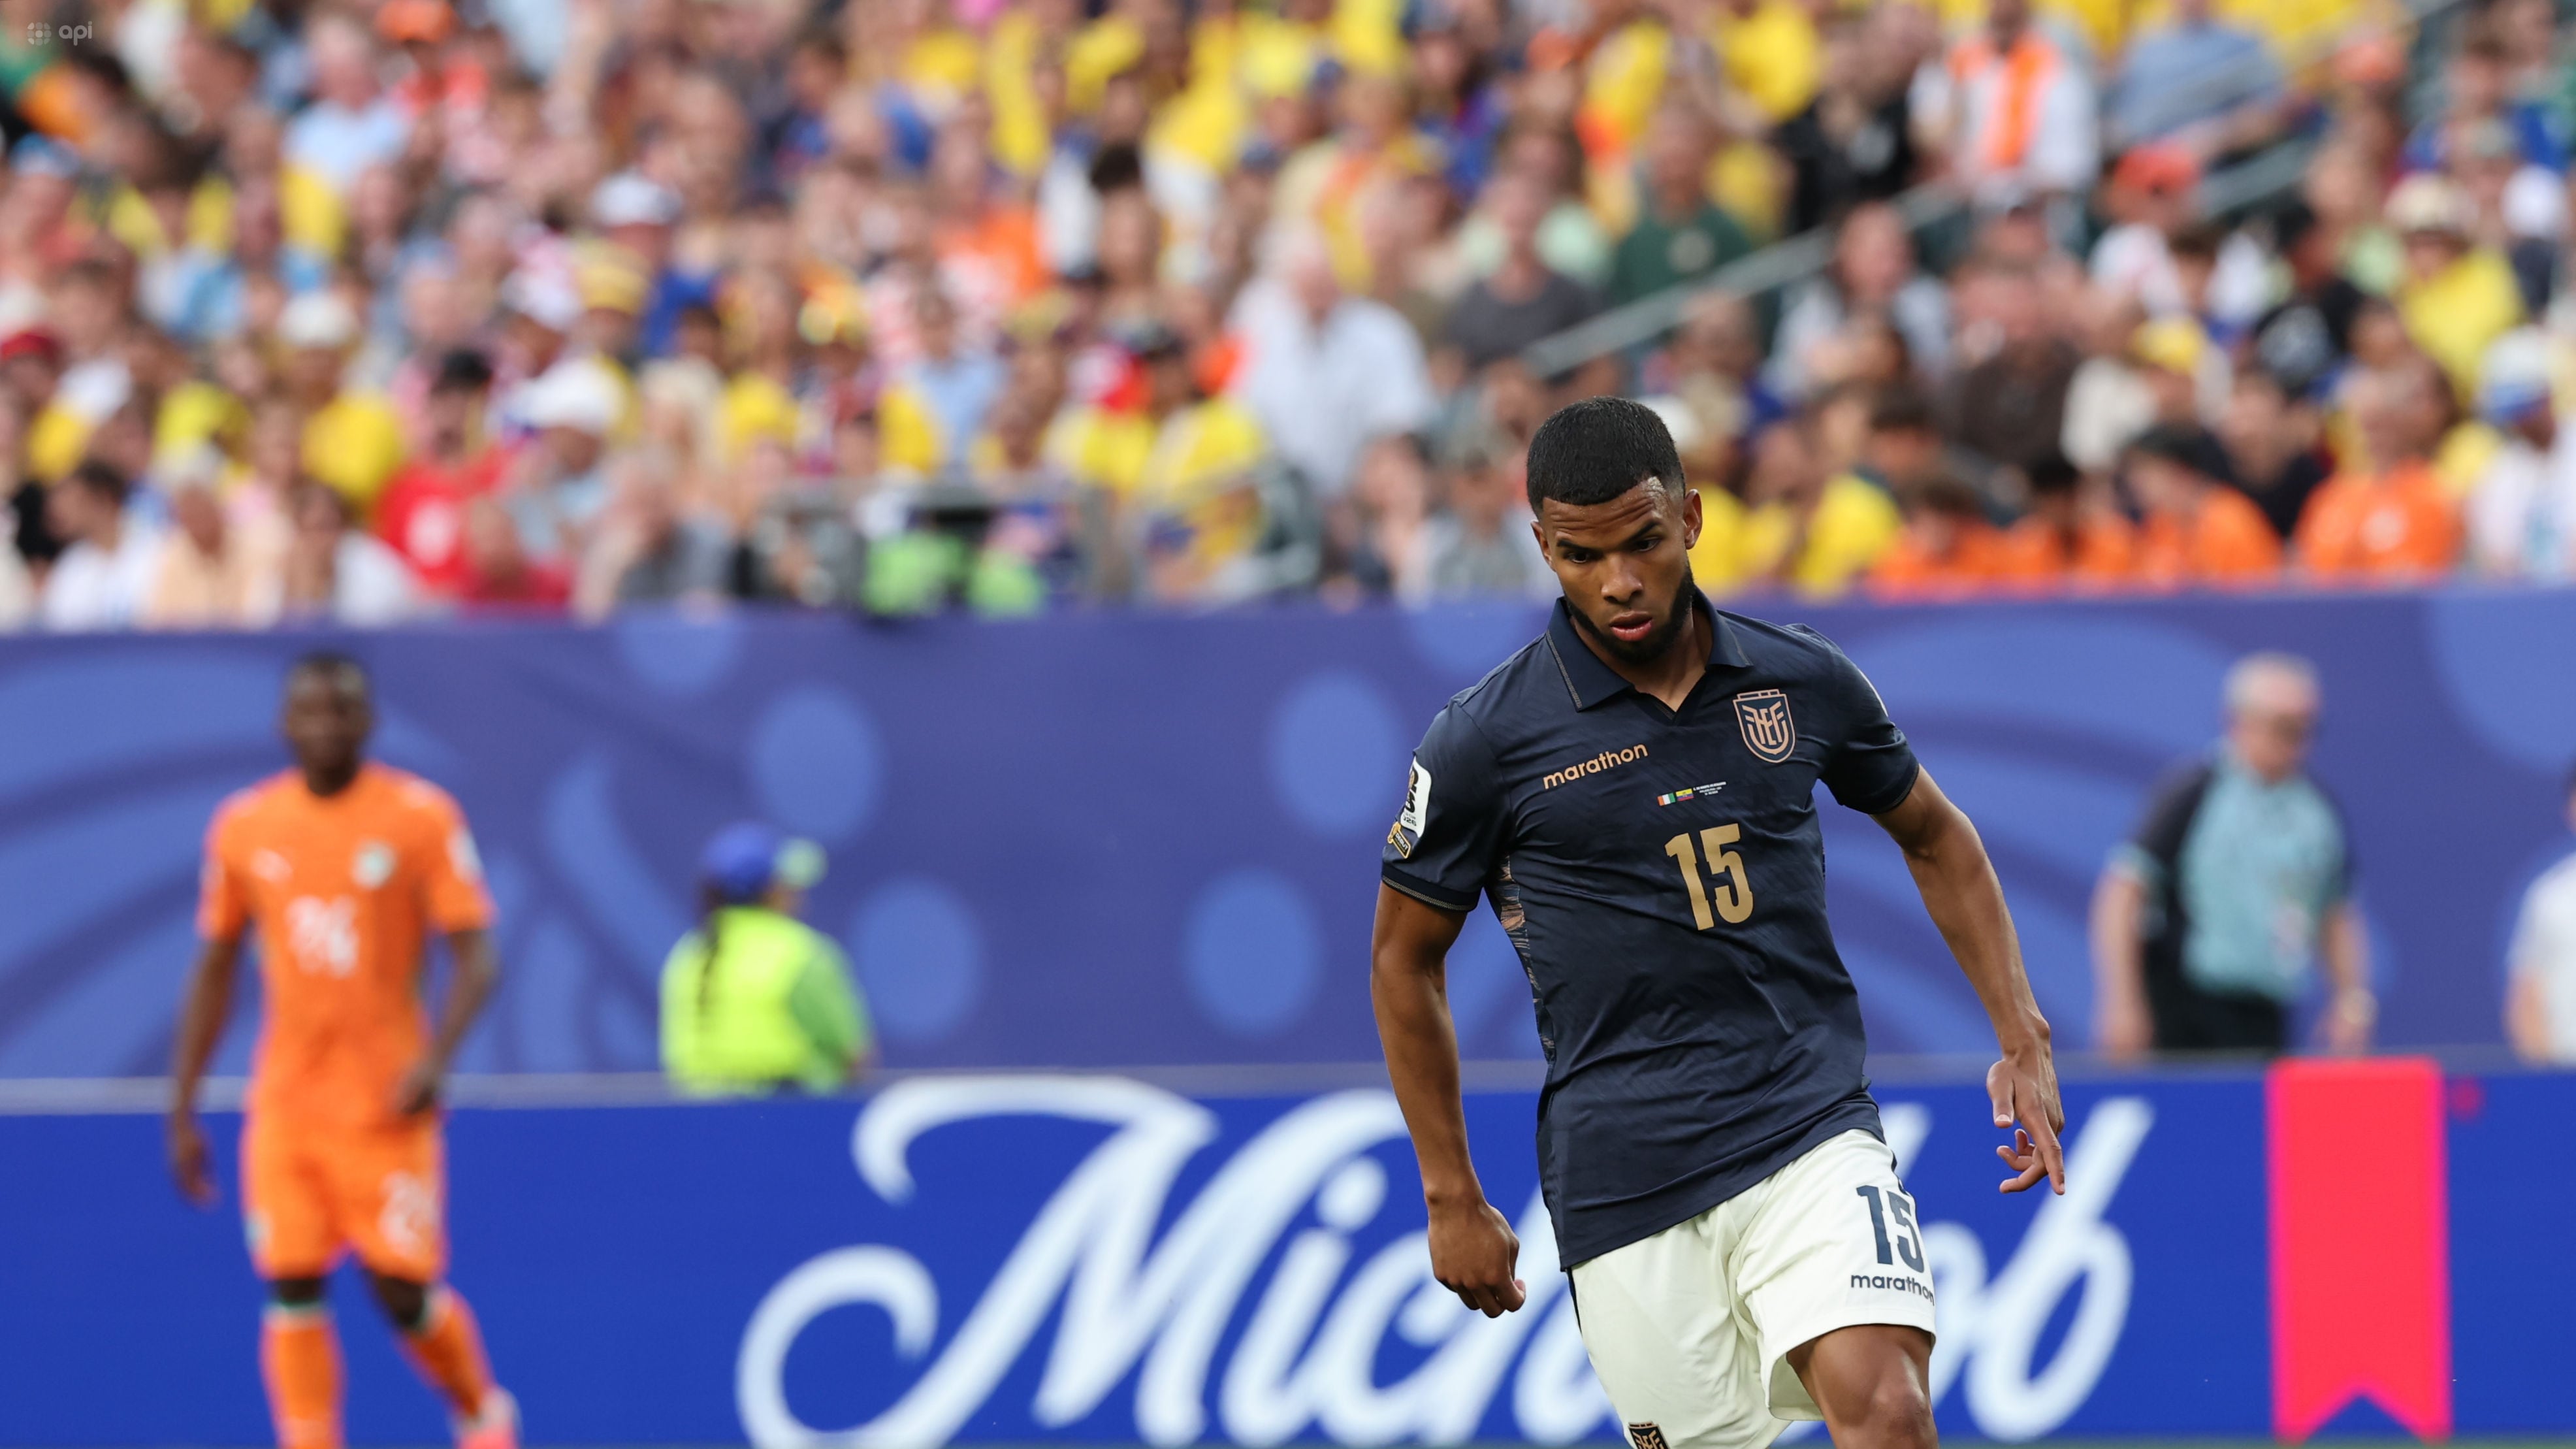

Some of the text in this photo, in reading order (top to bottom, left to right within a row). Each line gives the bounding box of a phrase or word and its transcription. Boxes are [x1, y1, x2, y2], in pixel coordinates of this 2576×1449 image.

[1543, 744, 1649, 790] marathon
[1664, 823, 1754, 931] 15
[1856, 1184, 1925, 1273] 15
[1850, 1275, 1935, 1307] marathon
